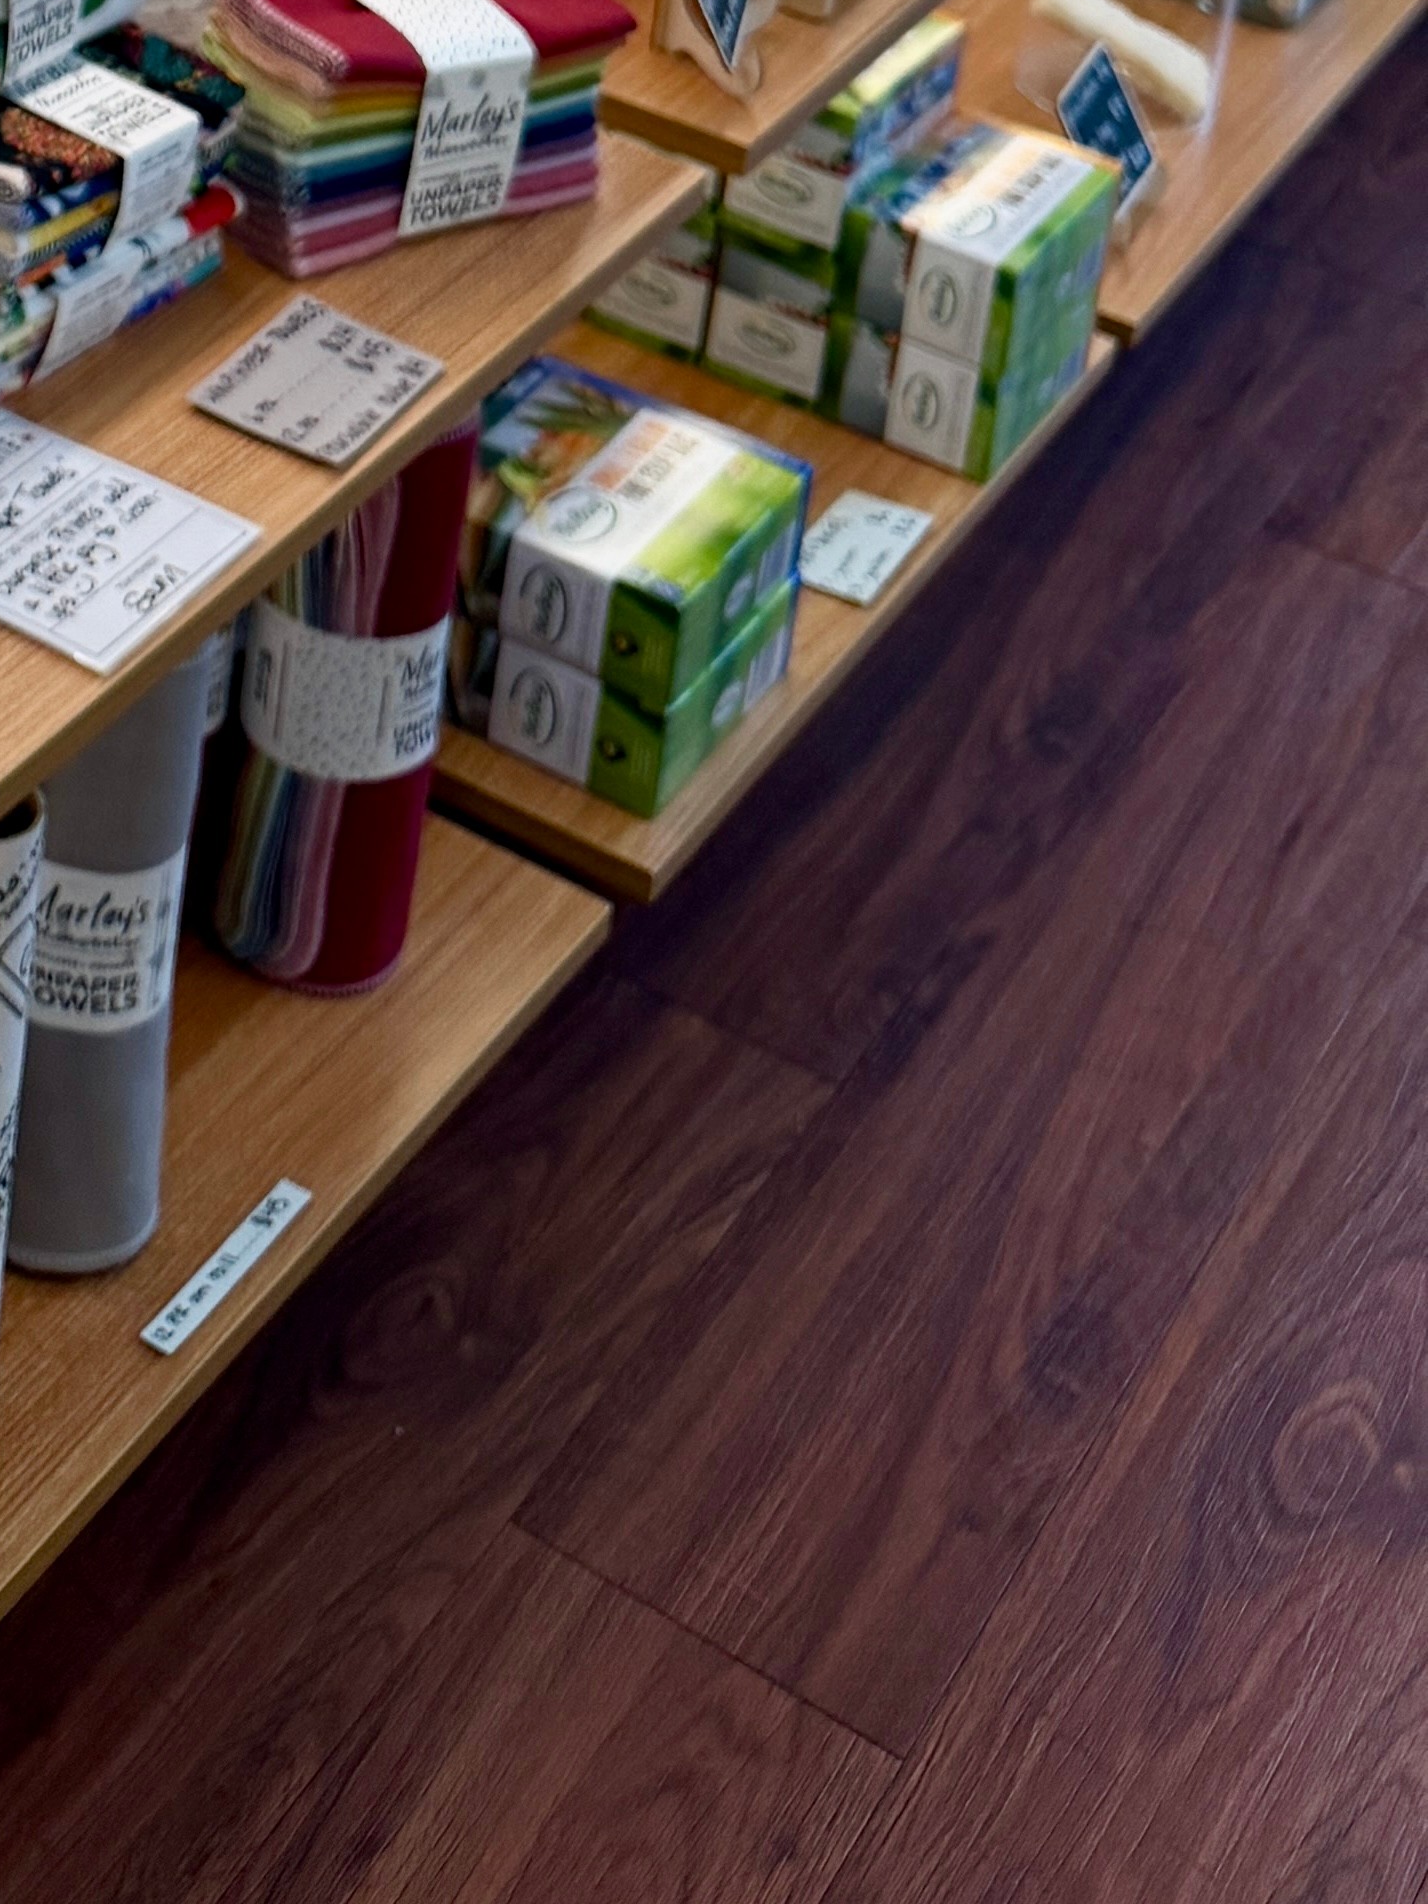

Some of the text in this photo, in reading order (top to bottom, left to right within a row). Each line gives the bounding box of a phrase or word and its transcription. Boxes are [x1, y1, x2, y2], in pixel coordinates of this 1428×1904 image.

[420, 94, 520, 143] Marley's
[410, 173, 503, 208] UNPAPER
[408, 191, 500, 227] TOWELS
